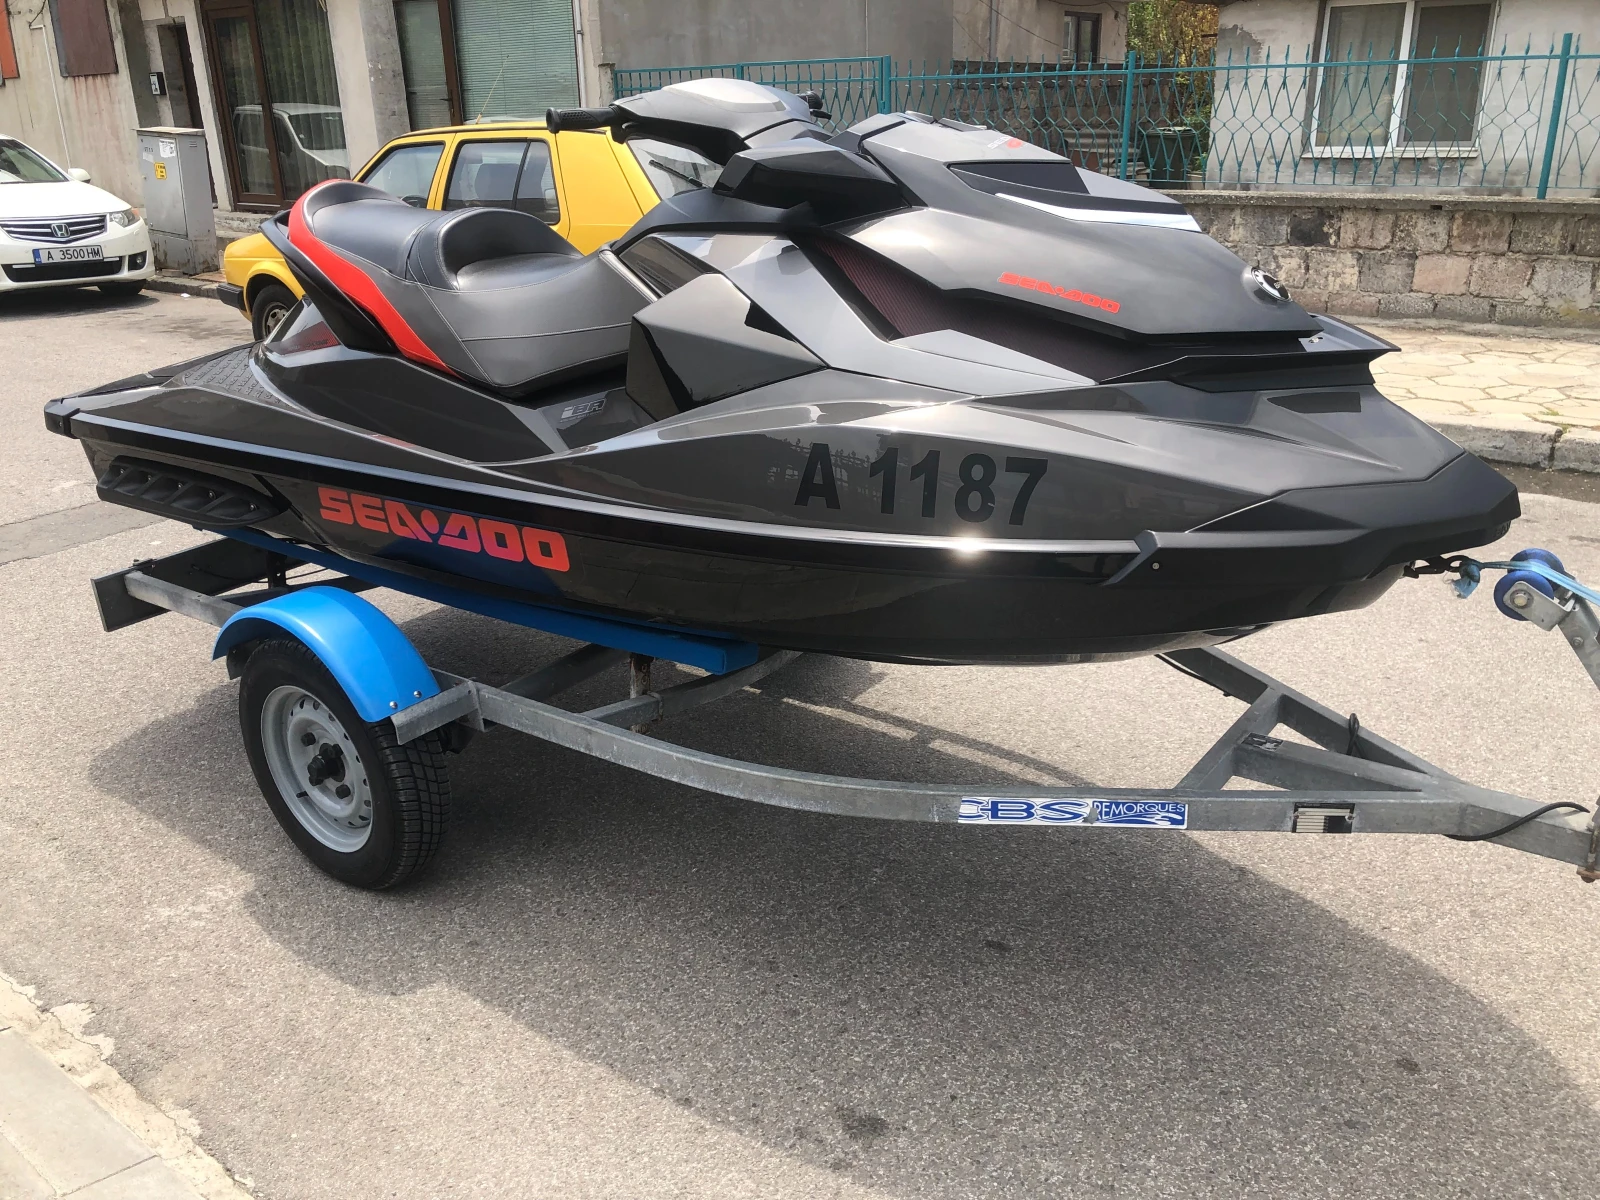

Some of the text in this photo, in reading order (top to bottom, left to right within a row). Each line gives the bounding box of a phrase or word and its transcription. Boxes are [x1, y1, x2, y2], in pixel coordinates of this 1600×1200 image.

[47, 251, 54, 261] A
[60, 249, 85, 260] 3500
[86, 248, 100, 258] HM
[794, 442, 1049, 526] A 1187
[1094, 801, 1185, 820] REMORQUES
